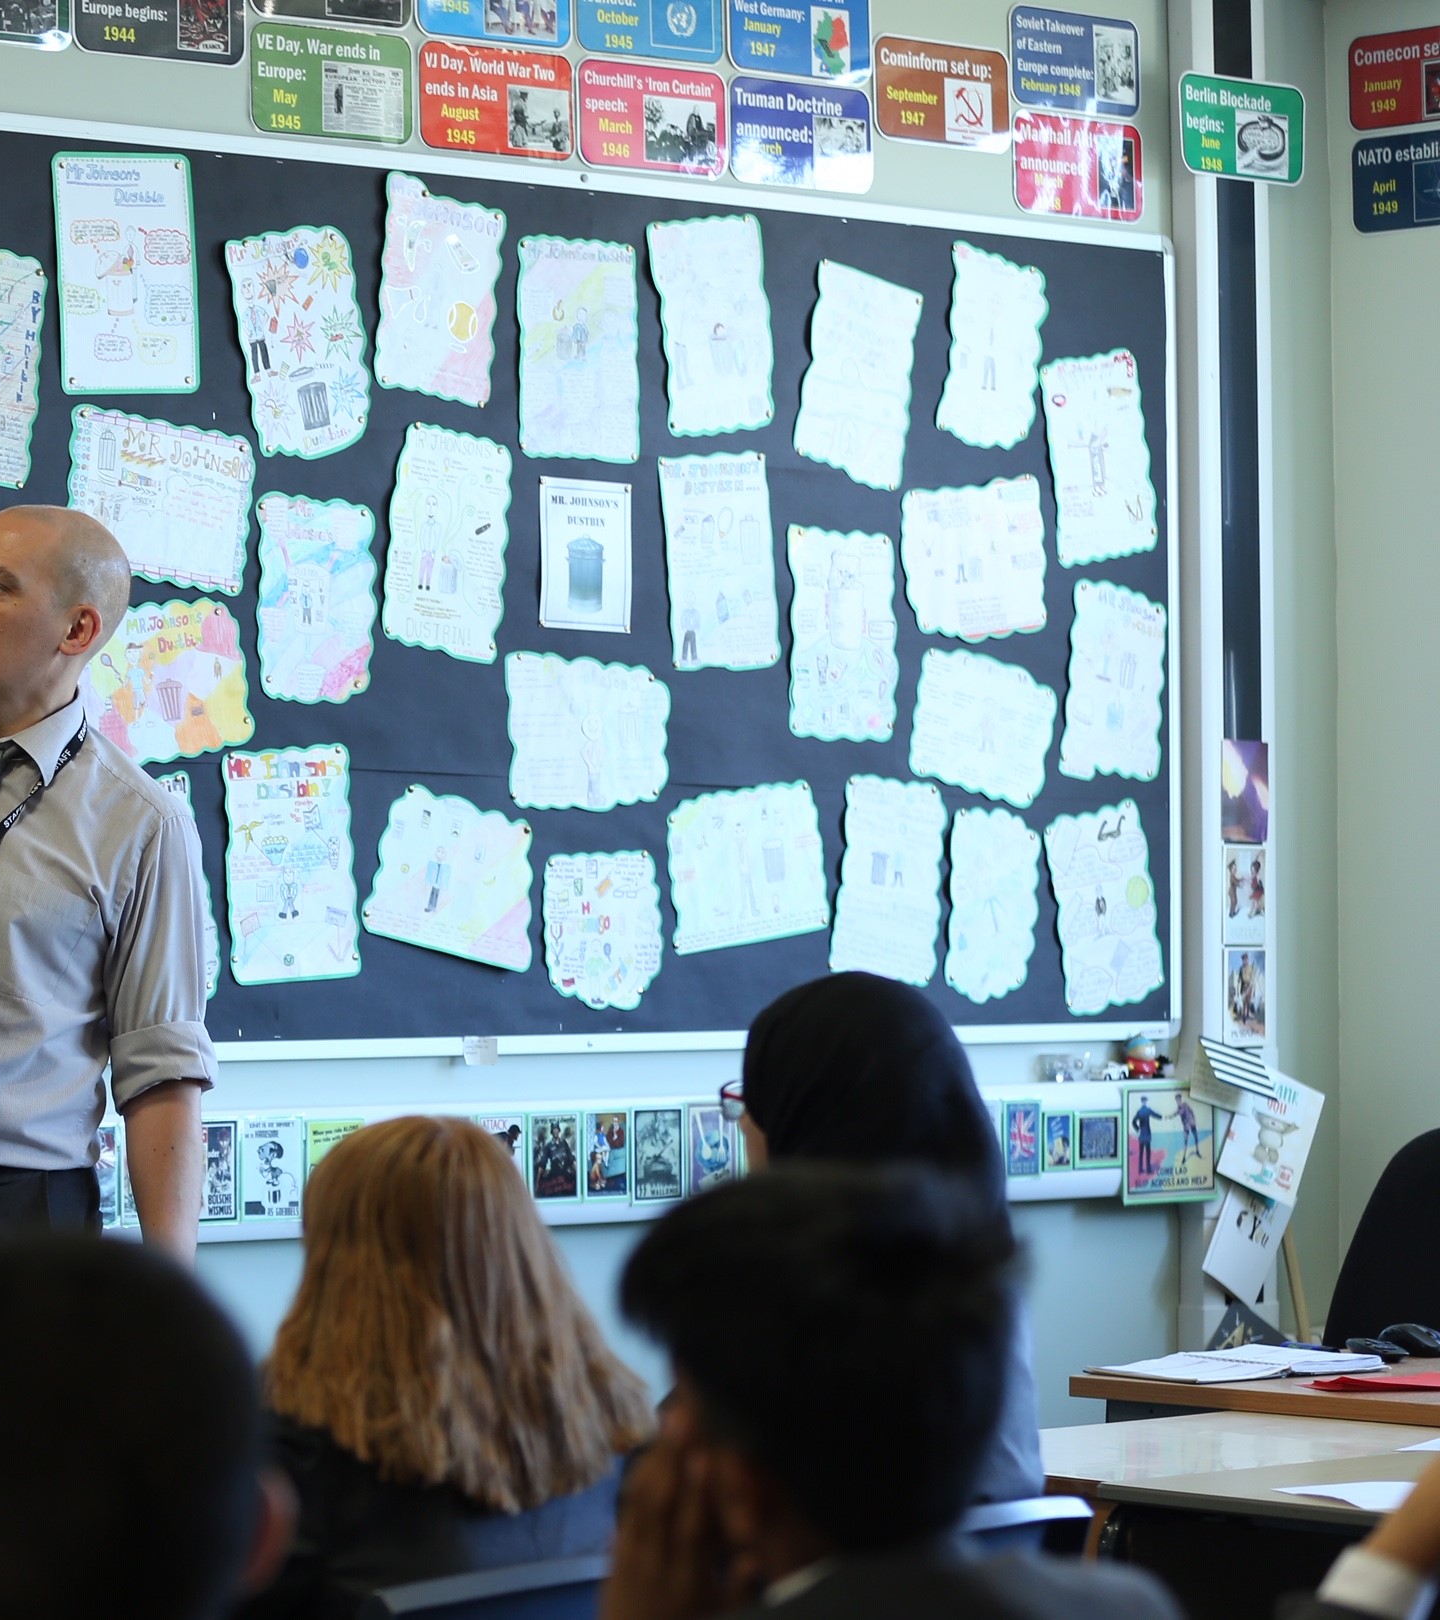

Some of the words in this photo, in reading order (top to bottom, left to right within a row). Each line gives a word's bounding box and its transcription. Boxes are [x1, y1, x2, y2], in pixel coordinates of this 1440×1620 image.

[82, 0, 122, 18] Europe
[126, 3, 168, 22] begins:
[597, 8, 639, 27] October
[734, 0, 759, 13] West
[760, 2, 805, 22] Germany:
[104, 26, 136, 43] 1944
[744, 17, 781, 38] January
[1016, 14, 1044, 31] Soviet
[1045, 19, 1085, 37] Takeover
[256, 33, 273, 50] VE
[277, 35, 304, 56] Day.
[307, 38, 333, 55] War
[336, 44, 366, 60] ends
[369, 45, 381, 61] in
[604, 34, 633, 50] 1945
[750, 42, 776, 57] 1947
[1017, 37, 1027, 50] of
[1028, 38, 1062, 55] Eastern
[1355, 45, 1420, 67] Comecon
[258, 61, 307, 83] Europe:
[425, 52, 437, 68] VJ
[440, 54, 467, 73] Day.
[470, 57, 504, 76] World
[507, 63, 530, 79] War
[533, 65, 555, 82] Two
[881, 49, 947, 73] Cominform
[950, 61, 970, 76] set
[972, 62, 992, 82] up:
[1017, 58, 1049, 75] Europe
[1050, 64, 1094, 81] complete:
[425, 83, 455, 98] ends
[458, 84, 469, 99] in
[471, 86, 498, 102] Asia
[584, 70, 643, 90] Churchill's
[645, 77, 669, 92] 'Iron
[672, 80, 714, 98] Curtain'
[1021, 77, 1058, 97] February
[1059, 84, 1081, 97] 1948
[1364, 78, 1402, 94] January
[273, 89, 298, 108] May
[735, 88, 784, 110] Truman
[787, 92, 843, 116] Doctrine
[886, 85, 938, 106] September
[1186, 85, 1217, 104] Berlin
[1220, 89, 1272, 112] Blockade
[441, 103, 480, 122] August
[585, 97, 628, 113] speech:
[1371, 98, 1397, 114] 1949
[271, 114, 301, 130] 1945
[599, 118, 632, 135] March
[900, 110, 925, 127] 1947
[1186, 113, 1225, 134] begins:
[446, 128, 476, 145] 1945
[736, 122, 813, 144] announced:
[602, 142, 630, 158] 1946
[1201, 135, 1221, 150] June
[1201, 156, 1223, 172] 1948
[1358, 148, 1392, 166] NATO
[1373, 180, 1397, 197] April
[1372, 201, 1399, 215] 1949
[551, 495, 567, 506] MR.
[570, 497, 619, 509] JOHNSON'S
[567, 515, 606, 527] DUSTBIN
[4, 803, 23, 828] STAFF
[483, 1119, 508, 1130] ATTACK
[1191, 1176, 1208, 1186] HELP
[208, 1205, 232, 1216] WISMUS
